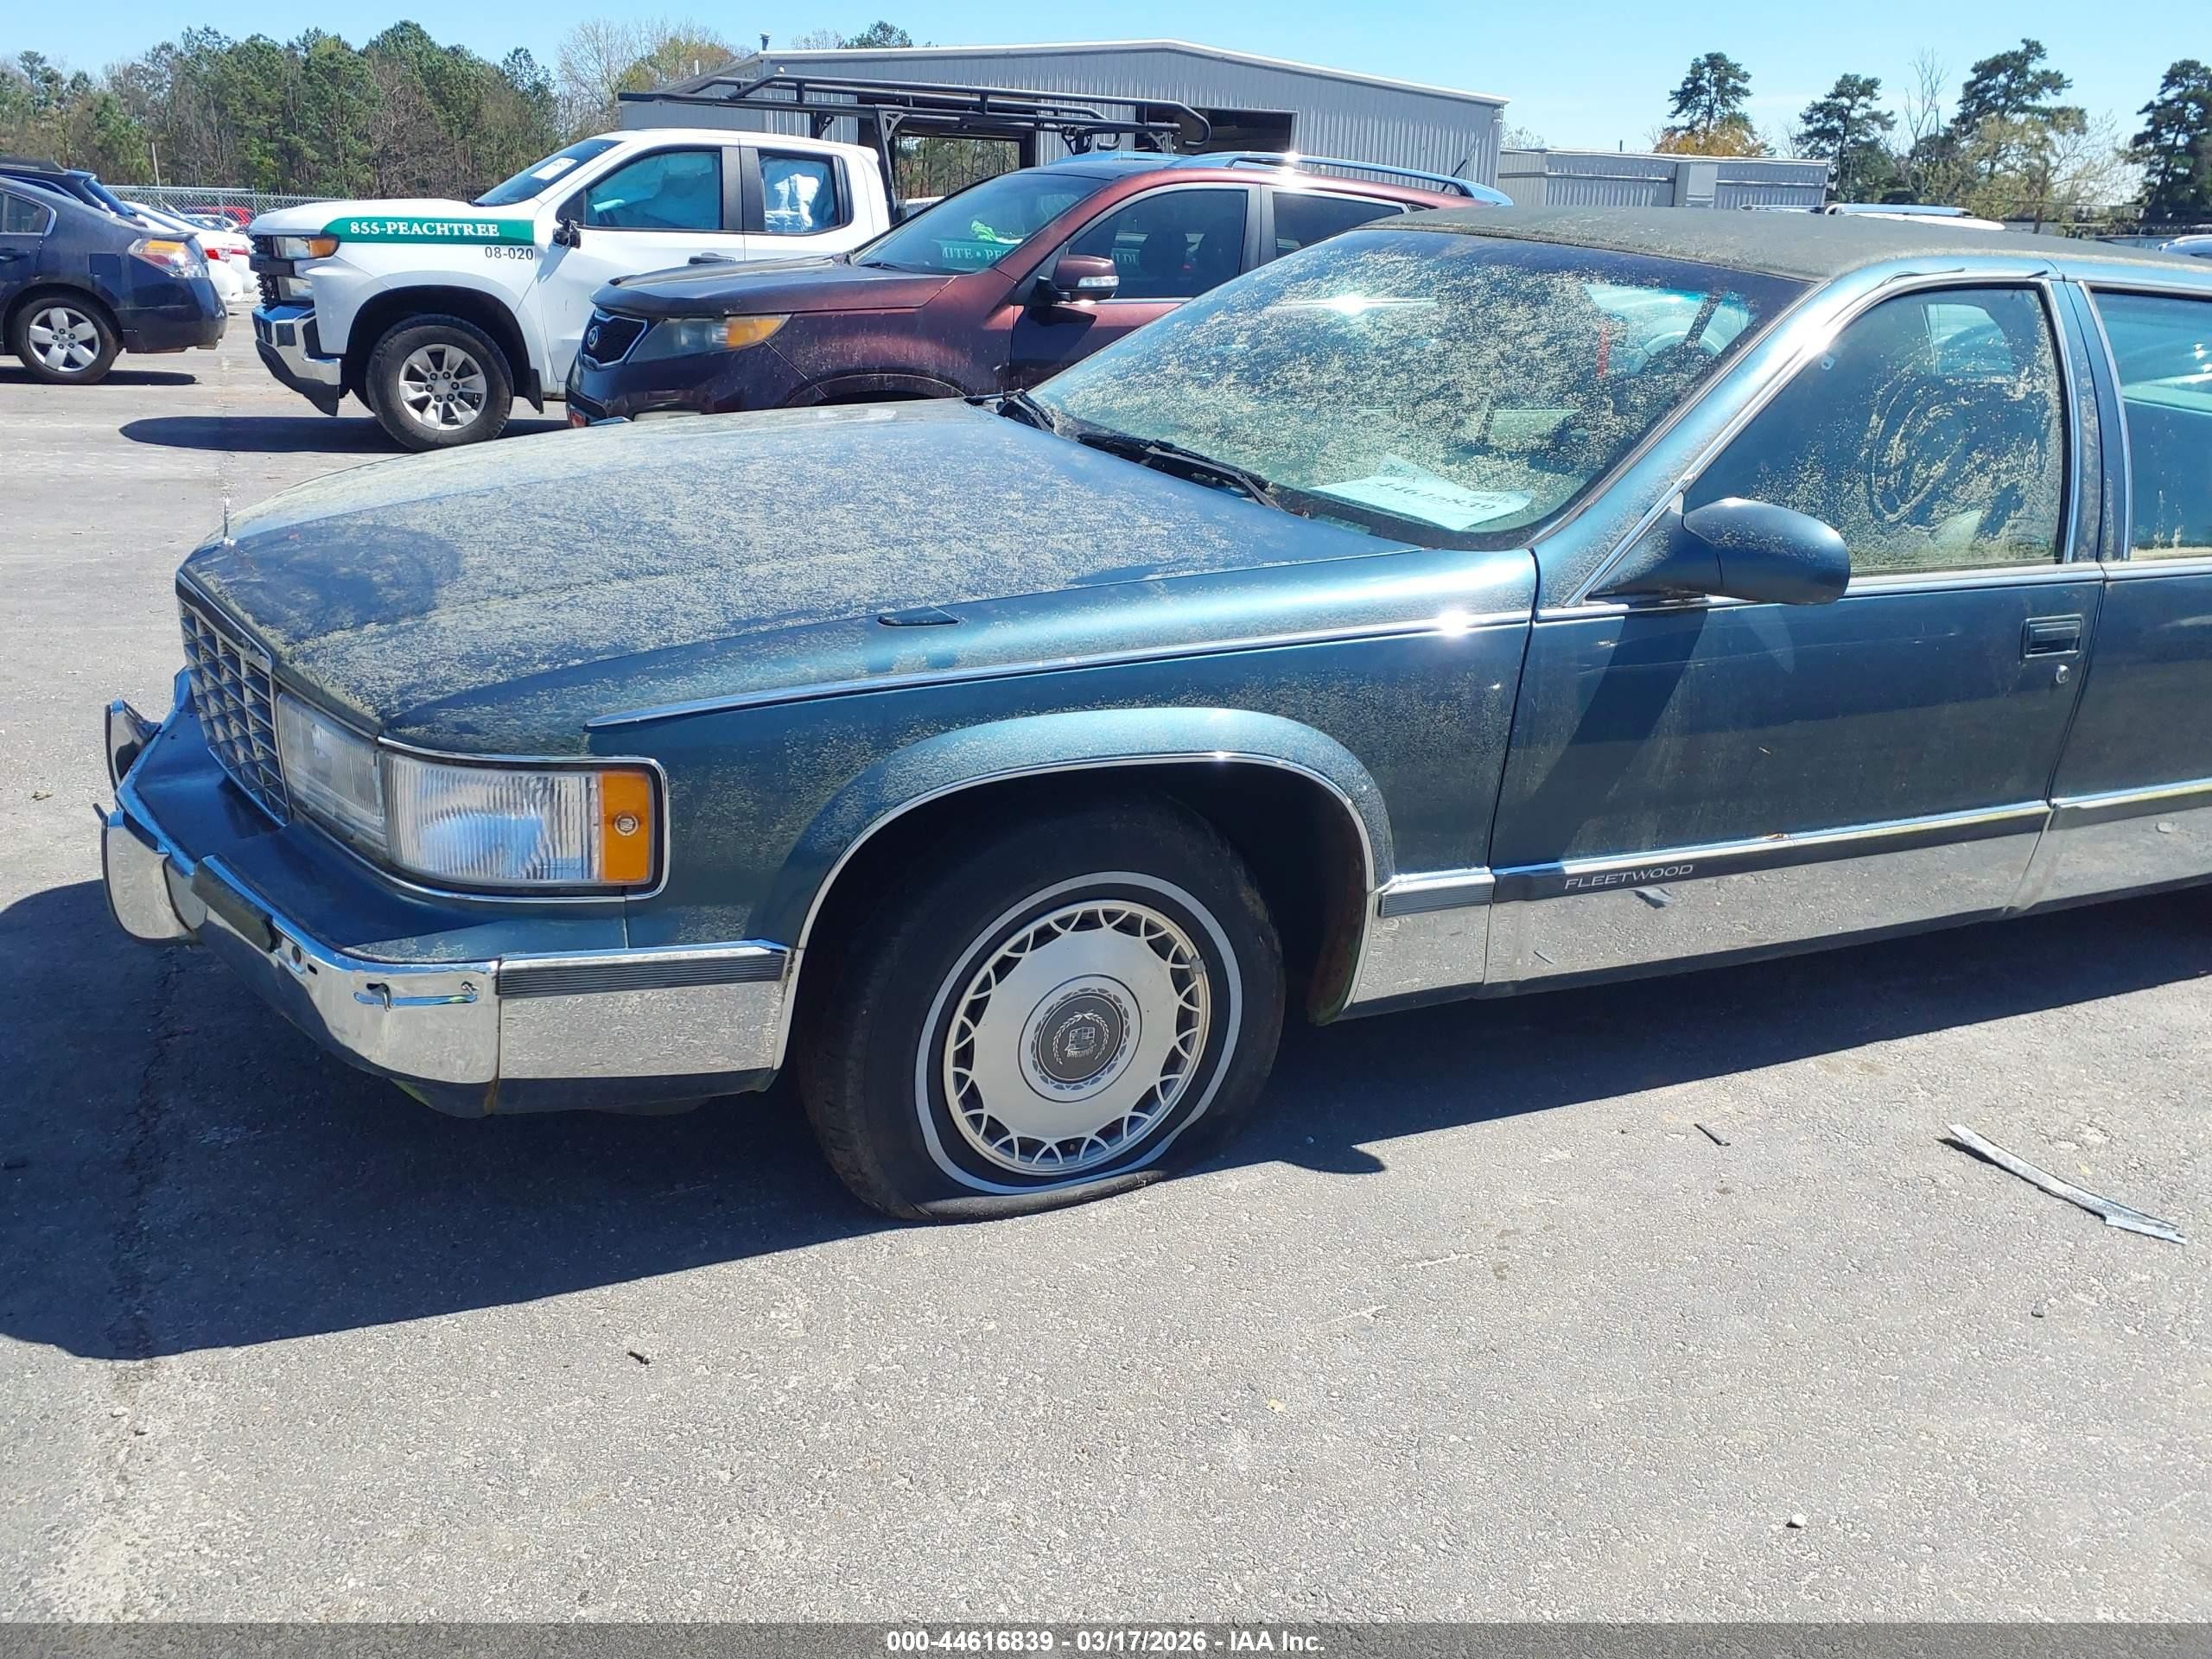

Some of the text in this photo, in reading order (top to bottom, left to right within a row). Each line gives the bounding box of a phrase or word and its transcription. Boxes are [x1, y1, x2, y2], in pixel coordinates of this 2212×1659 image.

[350, 221, 499, 237] 855-PEACHTREE
[485, 246, 533, 260] 08-020
[1564, 864, 1694, 890] FLEETWOOD
